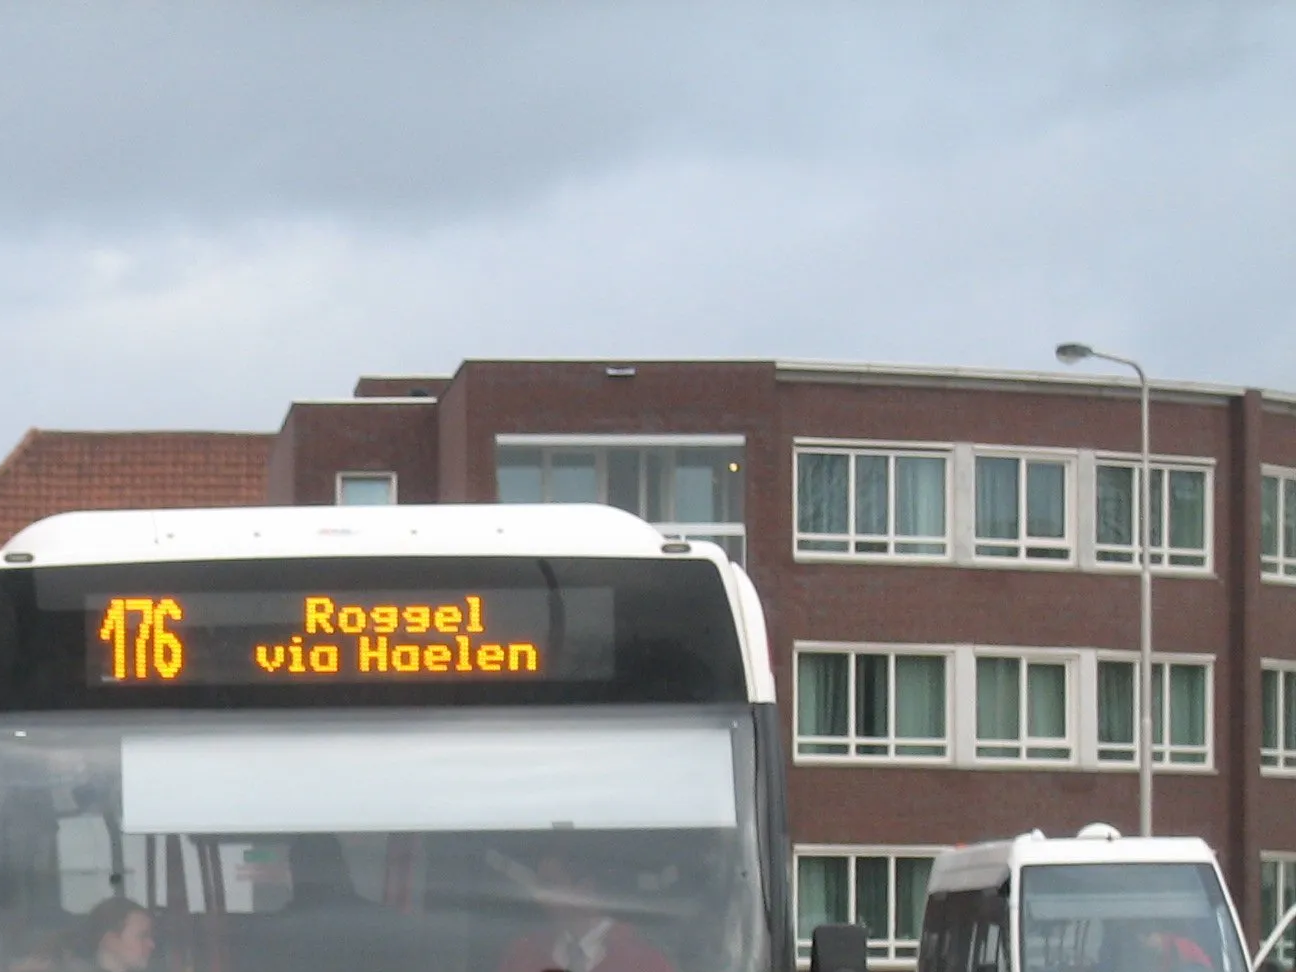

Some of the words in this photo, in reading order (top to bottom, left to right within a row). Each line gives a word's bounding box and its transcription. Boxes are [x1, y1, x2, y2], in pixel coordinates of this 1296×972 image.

[304, 596, 485, 634] Roggel
[100, 597, 184, 681] 176
[255, 635, 338, 673] via
[358, 635, 538, 672] Haelen
